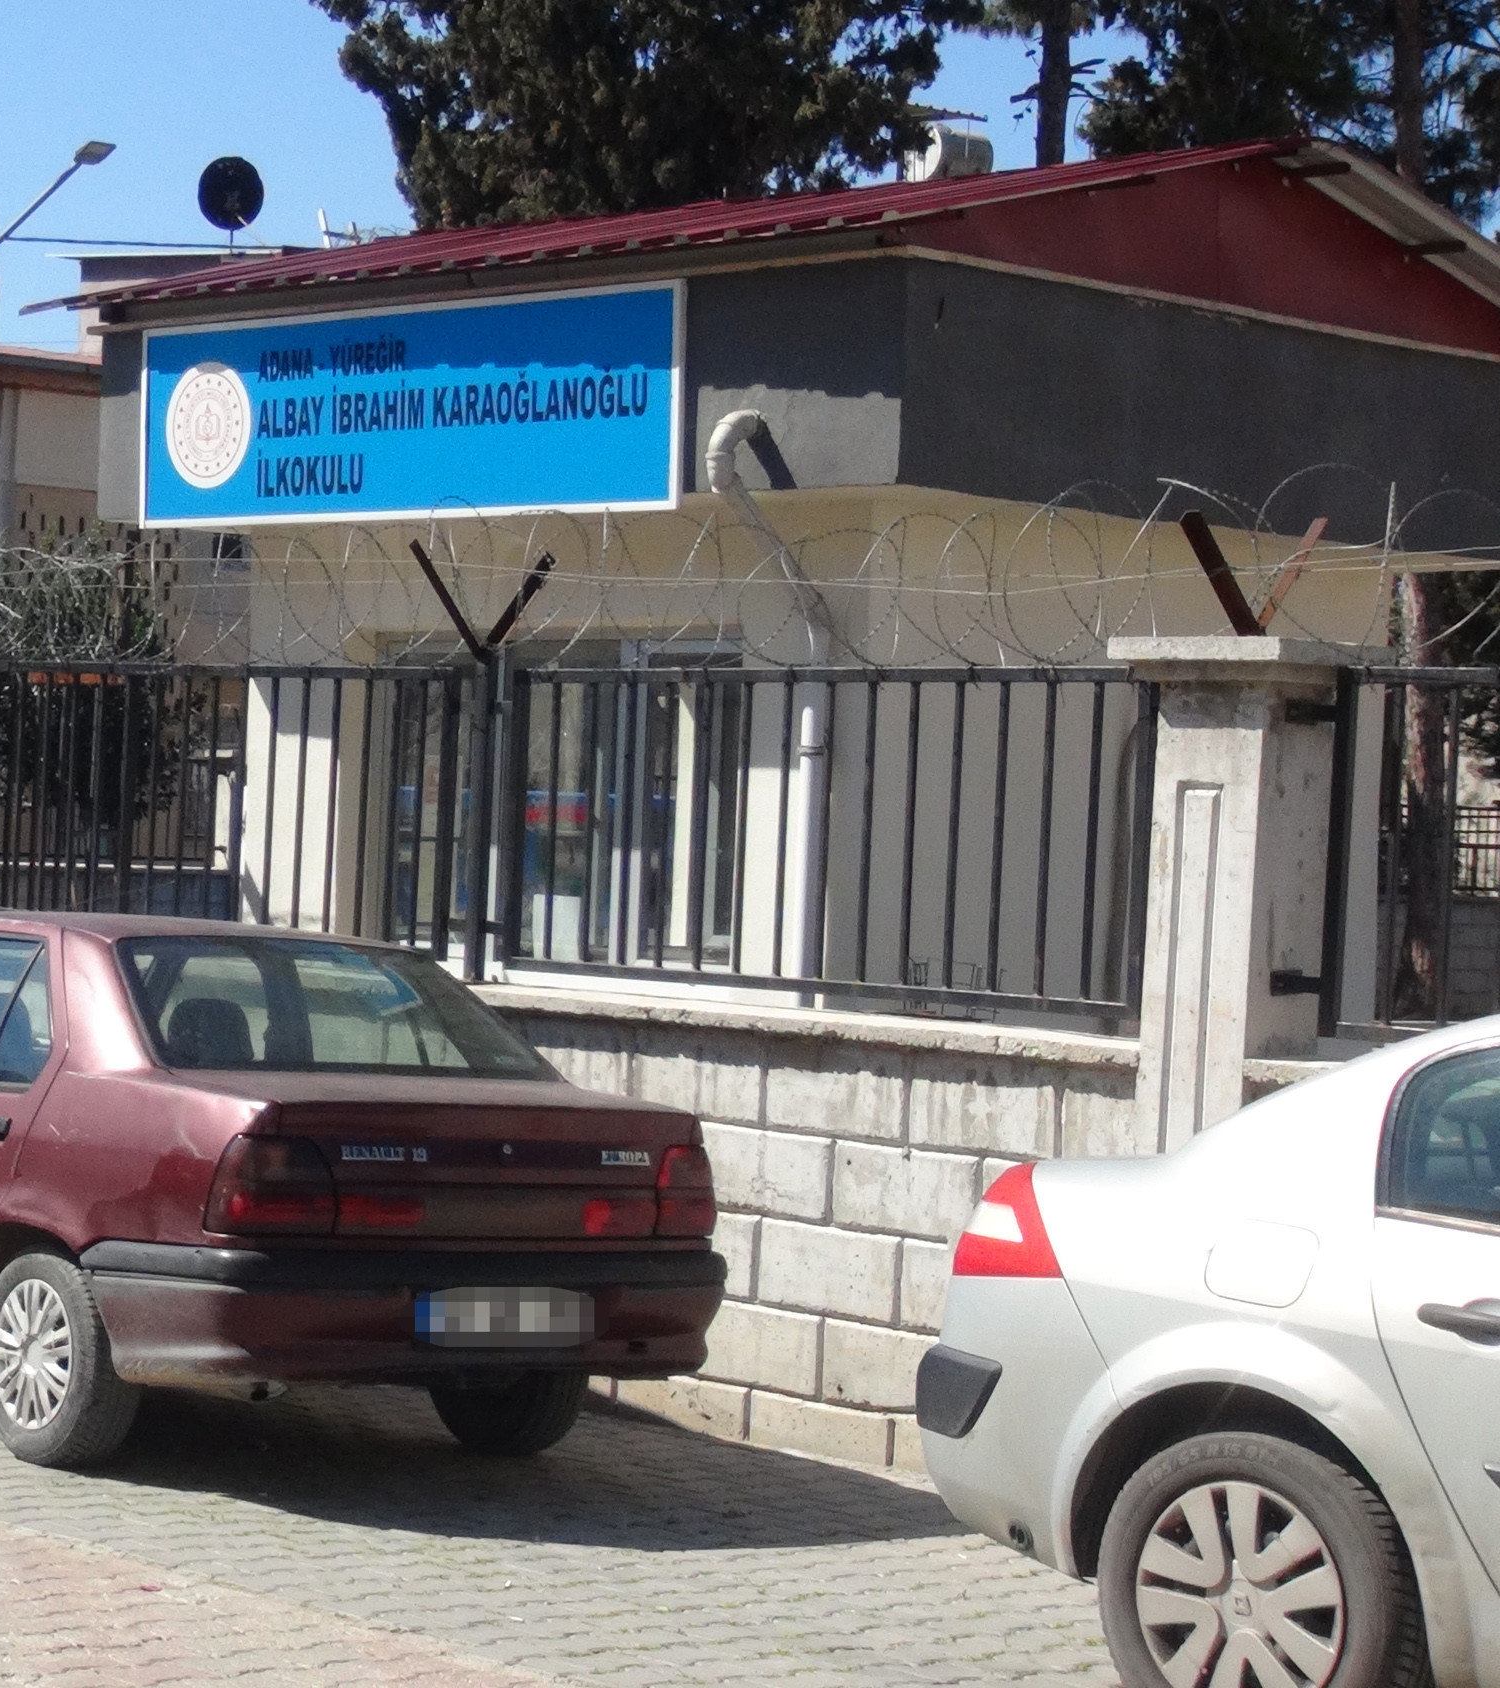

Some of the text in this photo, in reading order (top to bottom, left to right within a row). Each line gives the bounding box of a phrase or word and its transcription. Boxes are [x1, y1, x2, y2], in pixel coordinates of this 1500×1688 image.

[258, 347, 314, 383] ADANA
[329, 333, 406, 377] YÜREĞİR
[257, 394, 325, 439] ALBAY
[332, 379, 425, 435] İBRAHİM
[432, 363, 648, 428] KARAOĞLANOĞLU
[257, 450, 364, 498] İLKOKULU
[341, 1145, 428, 1162] RENAULT 19
[601, 1150, 651, 1167] EUROPA
